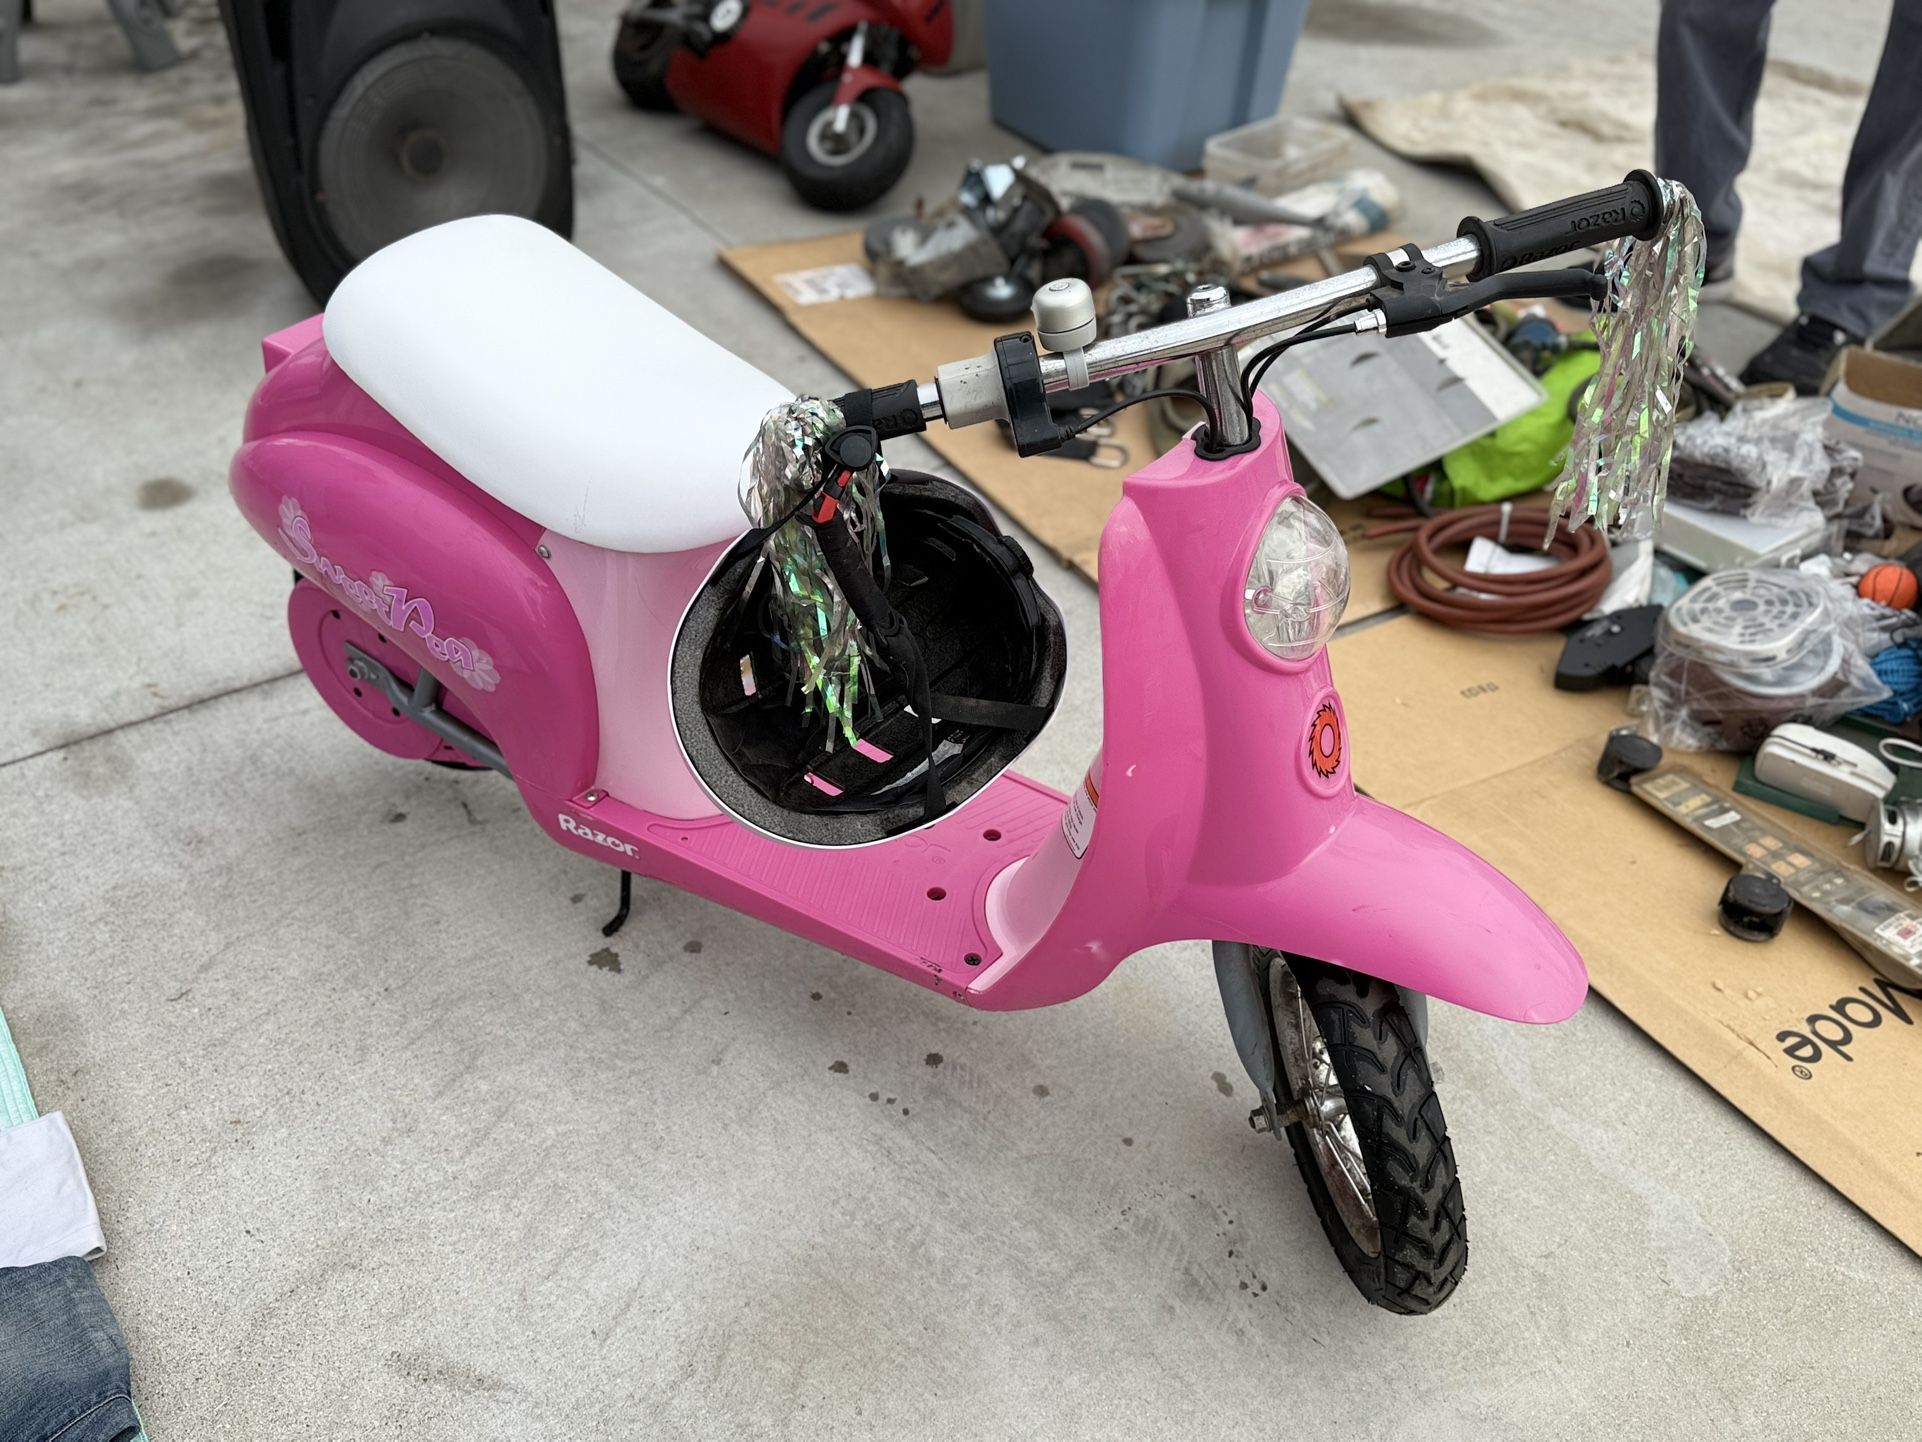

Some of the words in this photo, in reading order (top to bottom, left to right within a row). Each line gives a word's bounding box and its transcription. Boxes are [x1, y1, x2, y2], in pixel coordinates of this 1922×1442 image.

[1565, 207, 1626, 236] Razor
[383, 585, 475, 672] Pea
[558, 813, 639, 857] Razor
